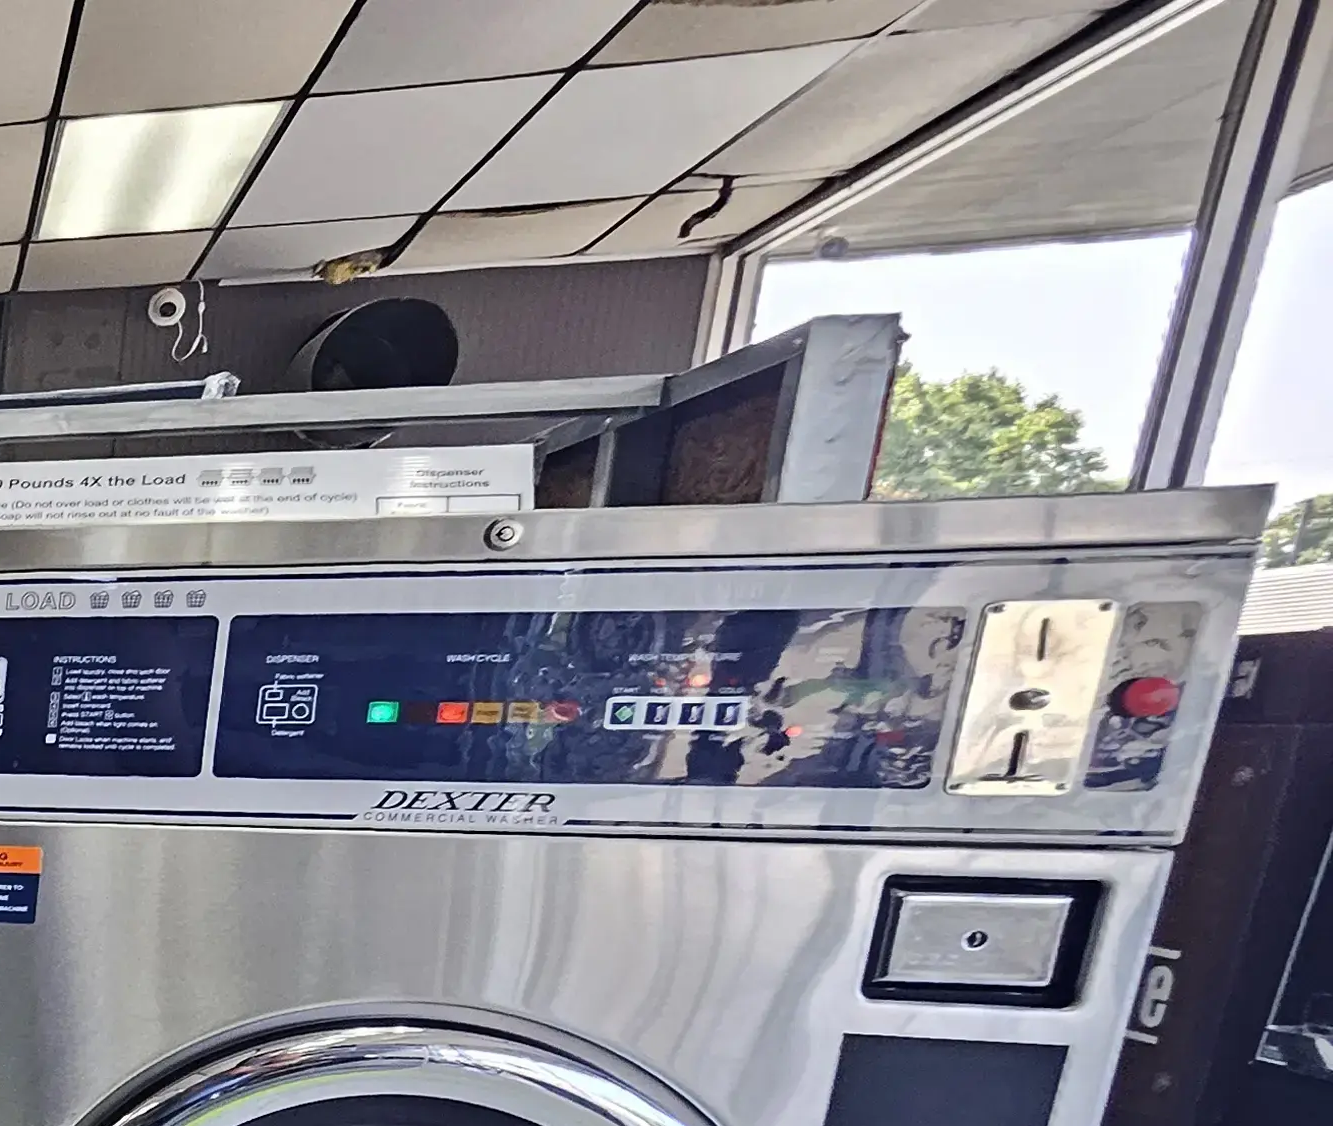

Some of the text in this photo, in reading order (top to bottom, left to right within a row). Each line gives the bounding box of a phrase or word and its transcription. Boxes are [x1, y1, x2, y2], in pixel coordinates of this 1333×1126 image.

[8, 477, 74, 490] Pounds
[79, 476, 102, 488] 4X
[108, 475, 135, 487] the
[141, 474, 186, 486] Load
[11, 500, 32, 510] (Do
[35, 500, 53, 509] not
[55, 500, 81, 508] over
[84, 499, 109, 508] load
[127, 497, 169, 506] clothes
[173, 496, 192, 504] will
[277, 493, 301, 502] end
[305, 492, 317, 502] of
[25, 512, 43, 520] will
[45, 512, 64, 520] not
[67, 511, 95, 519] rinse
[99, 510, 117, 518] out
[5, 592, 77, 611] LOAD
[53, 655, 117, 664] INSTRUCTIONS
[265, 654, 320, 664] DISPENSER
[371, 790, 556, 813] DEXTER
[363, 812, 558, 826] COMMERCIAL WASHER
